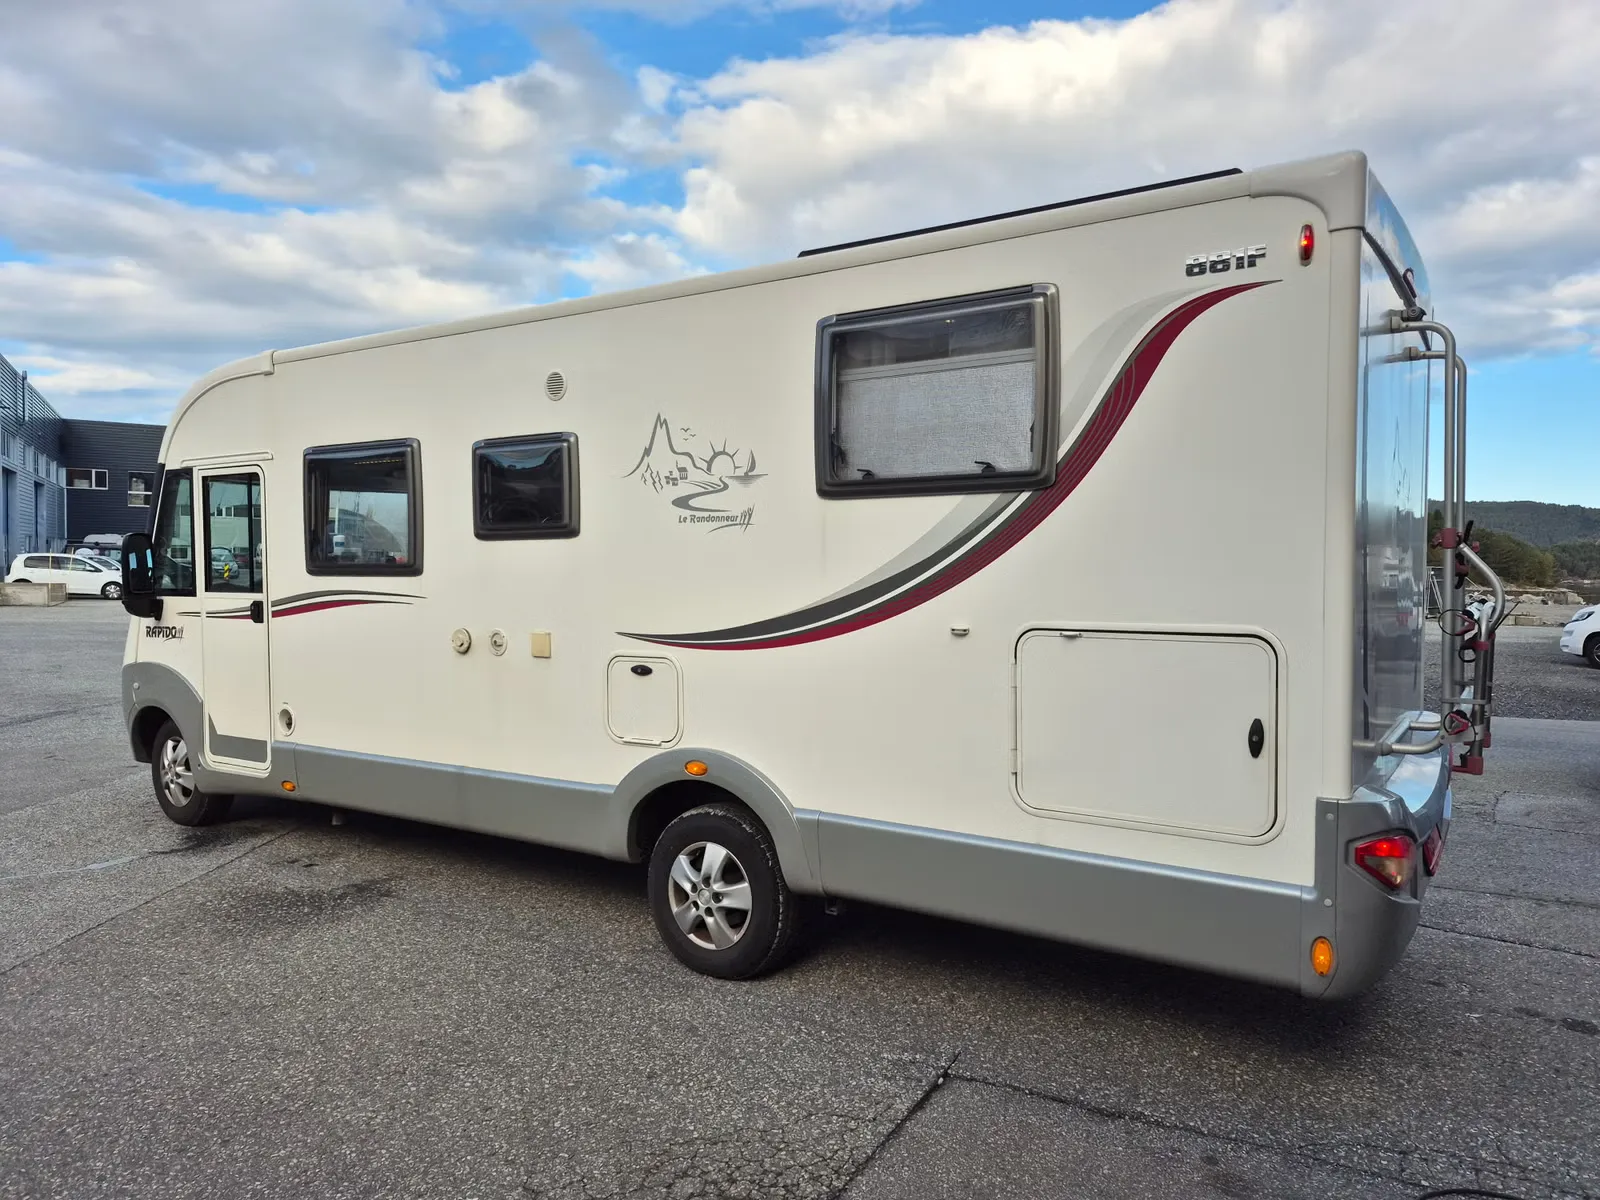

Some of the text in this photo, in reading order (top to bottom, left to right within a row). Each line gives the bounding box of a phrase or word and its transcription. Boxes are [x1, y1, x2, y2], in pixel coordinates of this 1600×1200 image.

[1185, 244, 1267, 277] 881F
[678, 514, 739, 524] Le Randonneur
